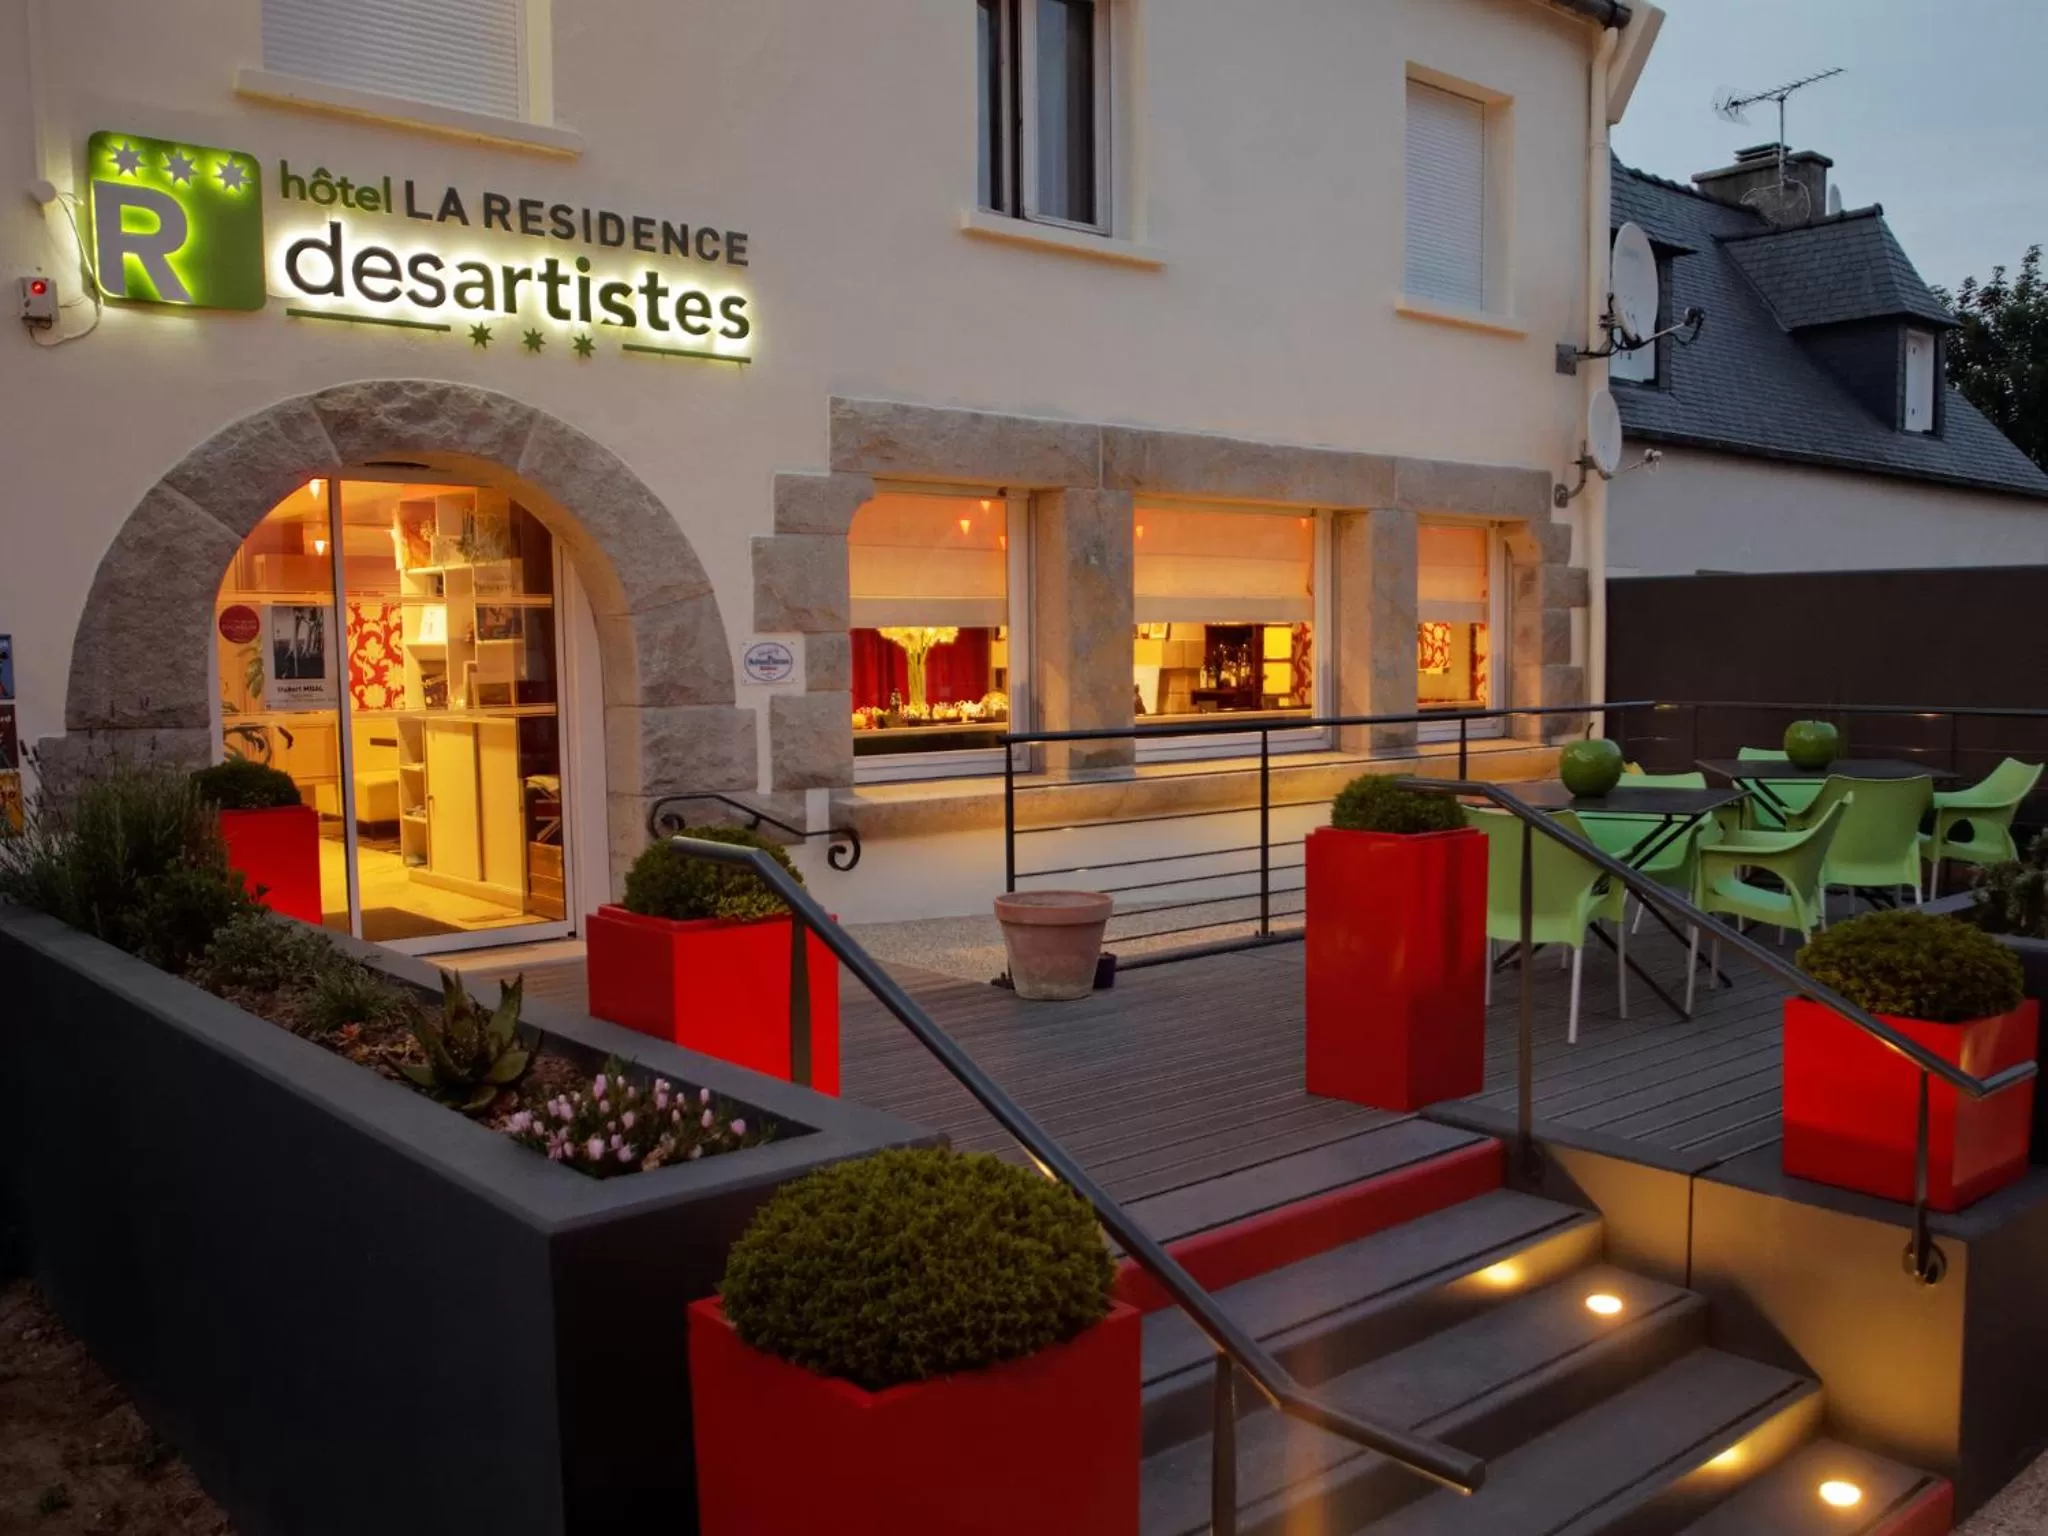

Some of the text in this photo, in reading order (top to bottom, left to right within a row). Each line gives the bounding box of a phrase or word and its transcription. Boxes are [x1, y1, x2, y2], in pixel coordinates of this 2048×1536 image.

[94, 179, 191, 301] R
[280, 159, 749, 267] hôtel LA RESIDENCE
